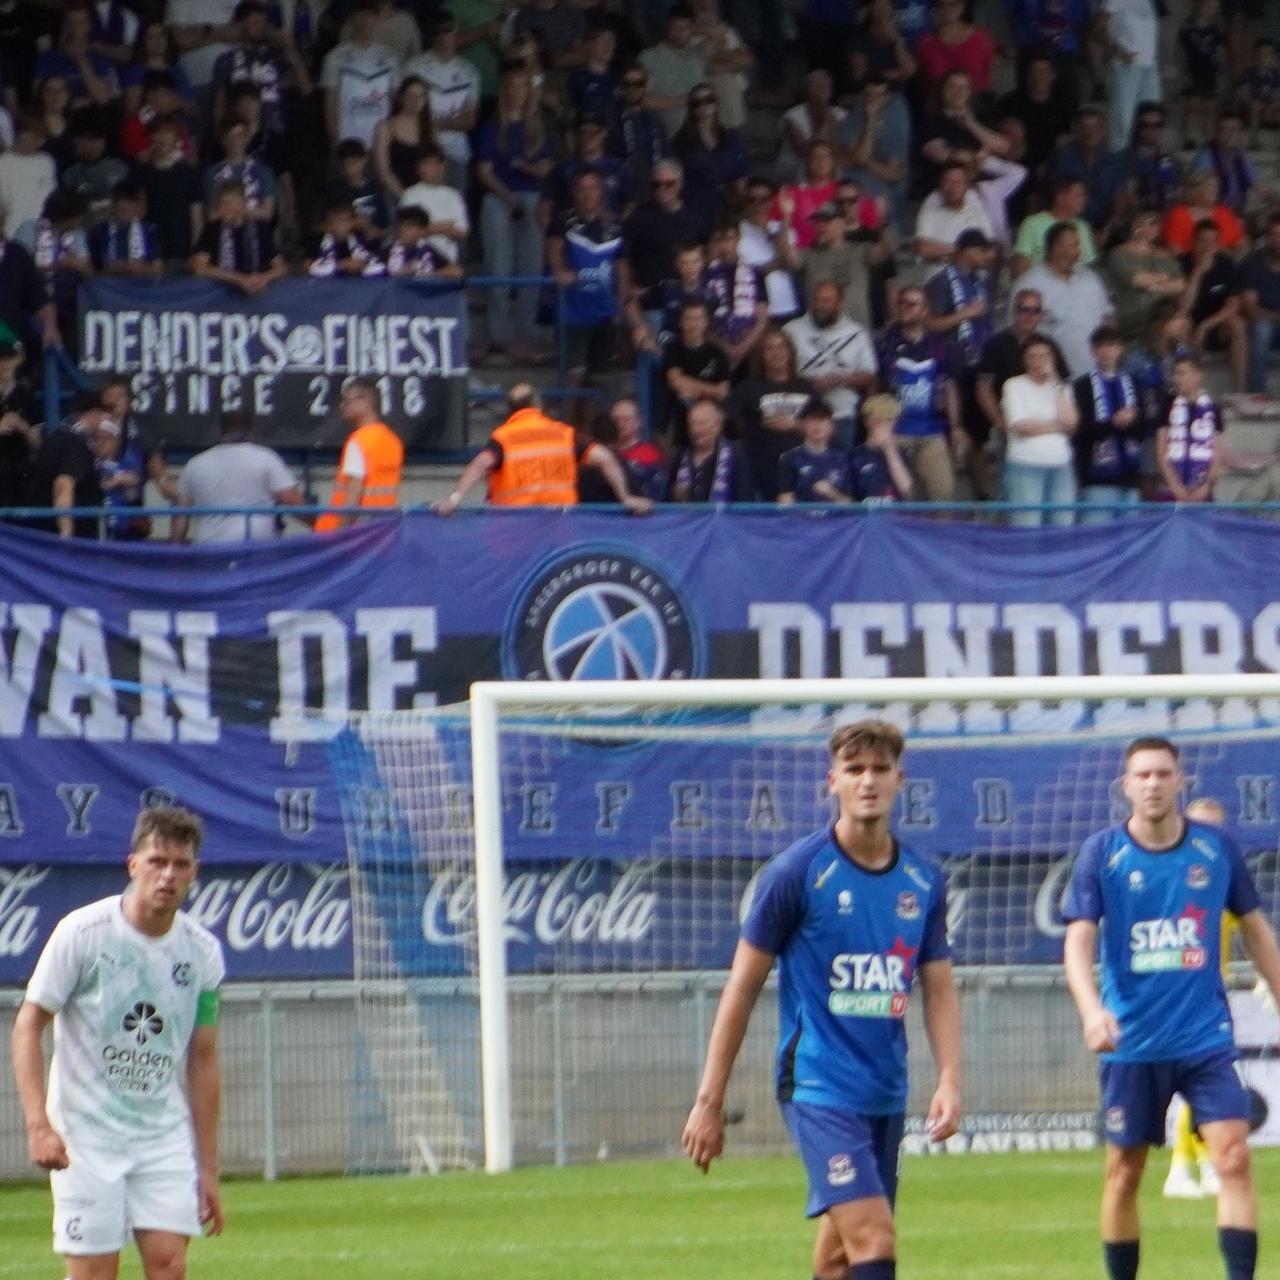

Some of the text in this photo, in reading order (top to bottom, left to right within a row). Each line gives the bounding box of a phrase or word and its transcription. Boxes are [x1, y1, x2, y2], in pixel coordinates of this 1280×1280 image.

[84, 310, 459, 376] DENDER'S FINEST
[130, 372, 427, 418] SINCE 218
[267, 606, 439, 743] DE
[1130, 917, 1201, 951] STAR
[829, 952, 906, 991] STAR
[834, 994, 890, 1012] SPORT
